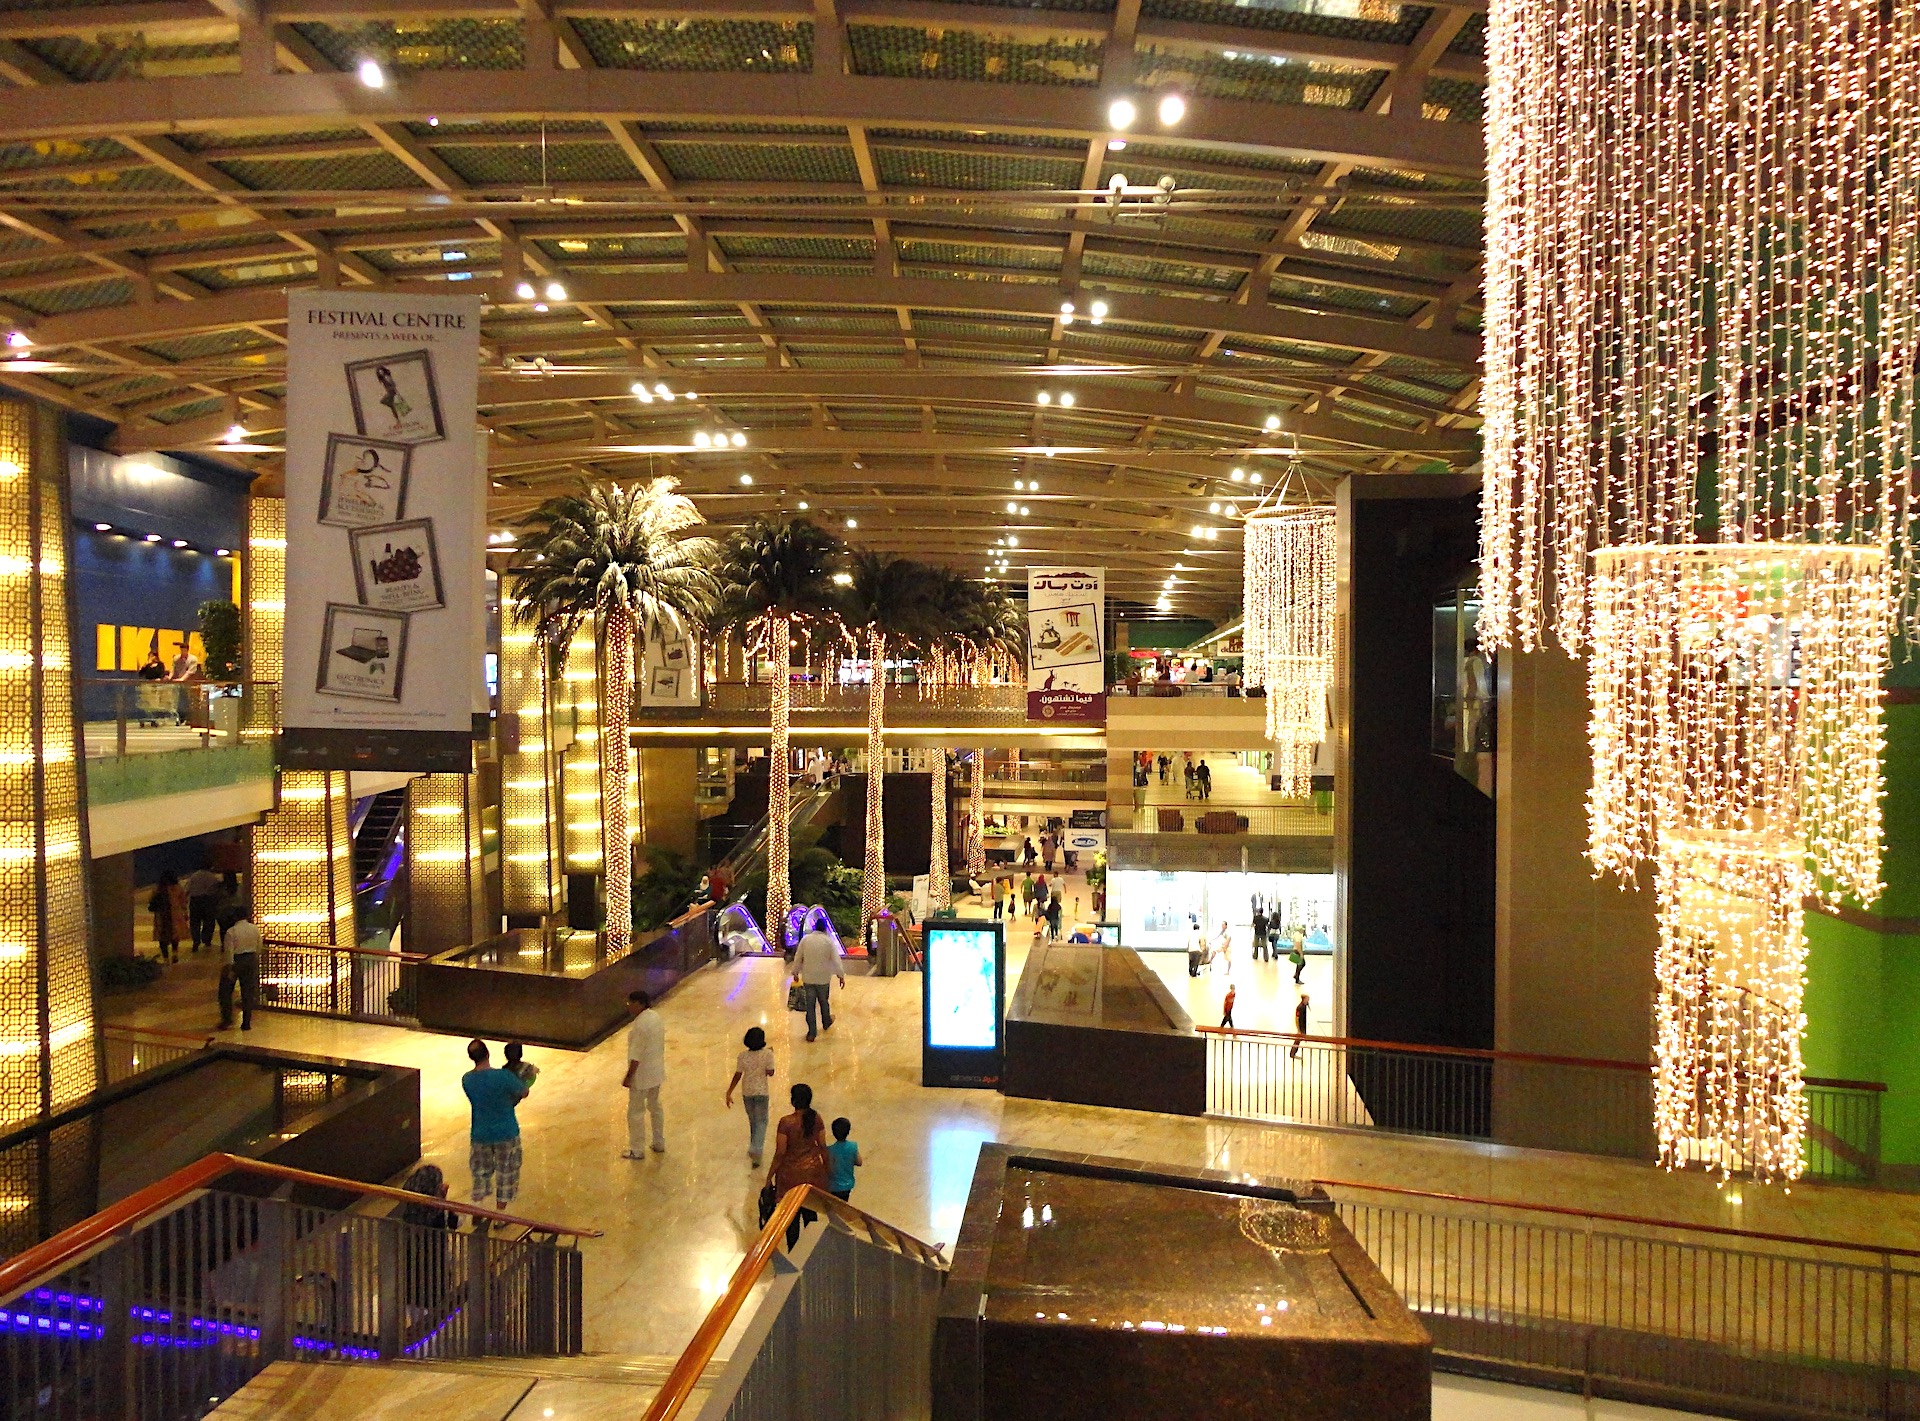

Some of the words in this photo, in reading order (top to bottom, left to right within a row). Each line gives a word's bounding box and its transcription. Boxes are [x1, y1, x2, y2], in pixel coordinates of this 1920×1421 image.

[308, 310, 387, 327] FESTIVAL
[393, 312, 465, 329] CENTRE
[333, 331, 381, 340] PRESENTS
[391, 333, 418, 341] WEEK
